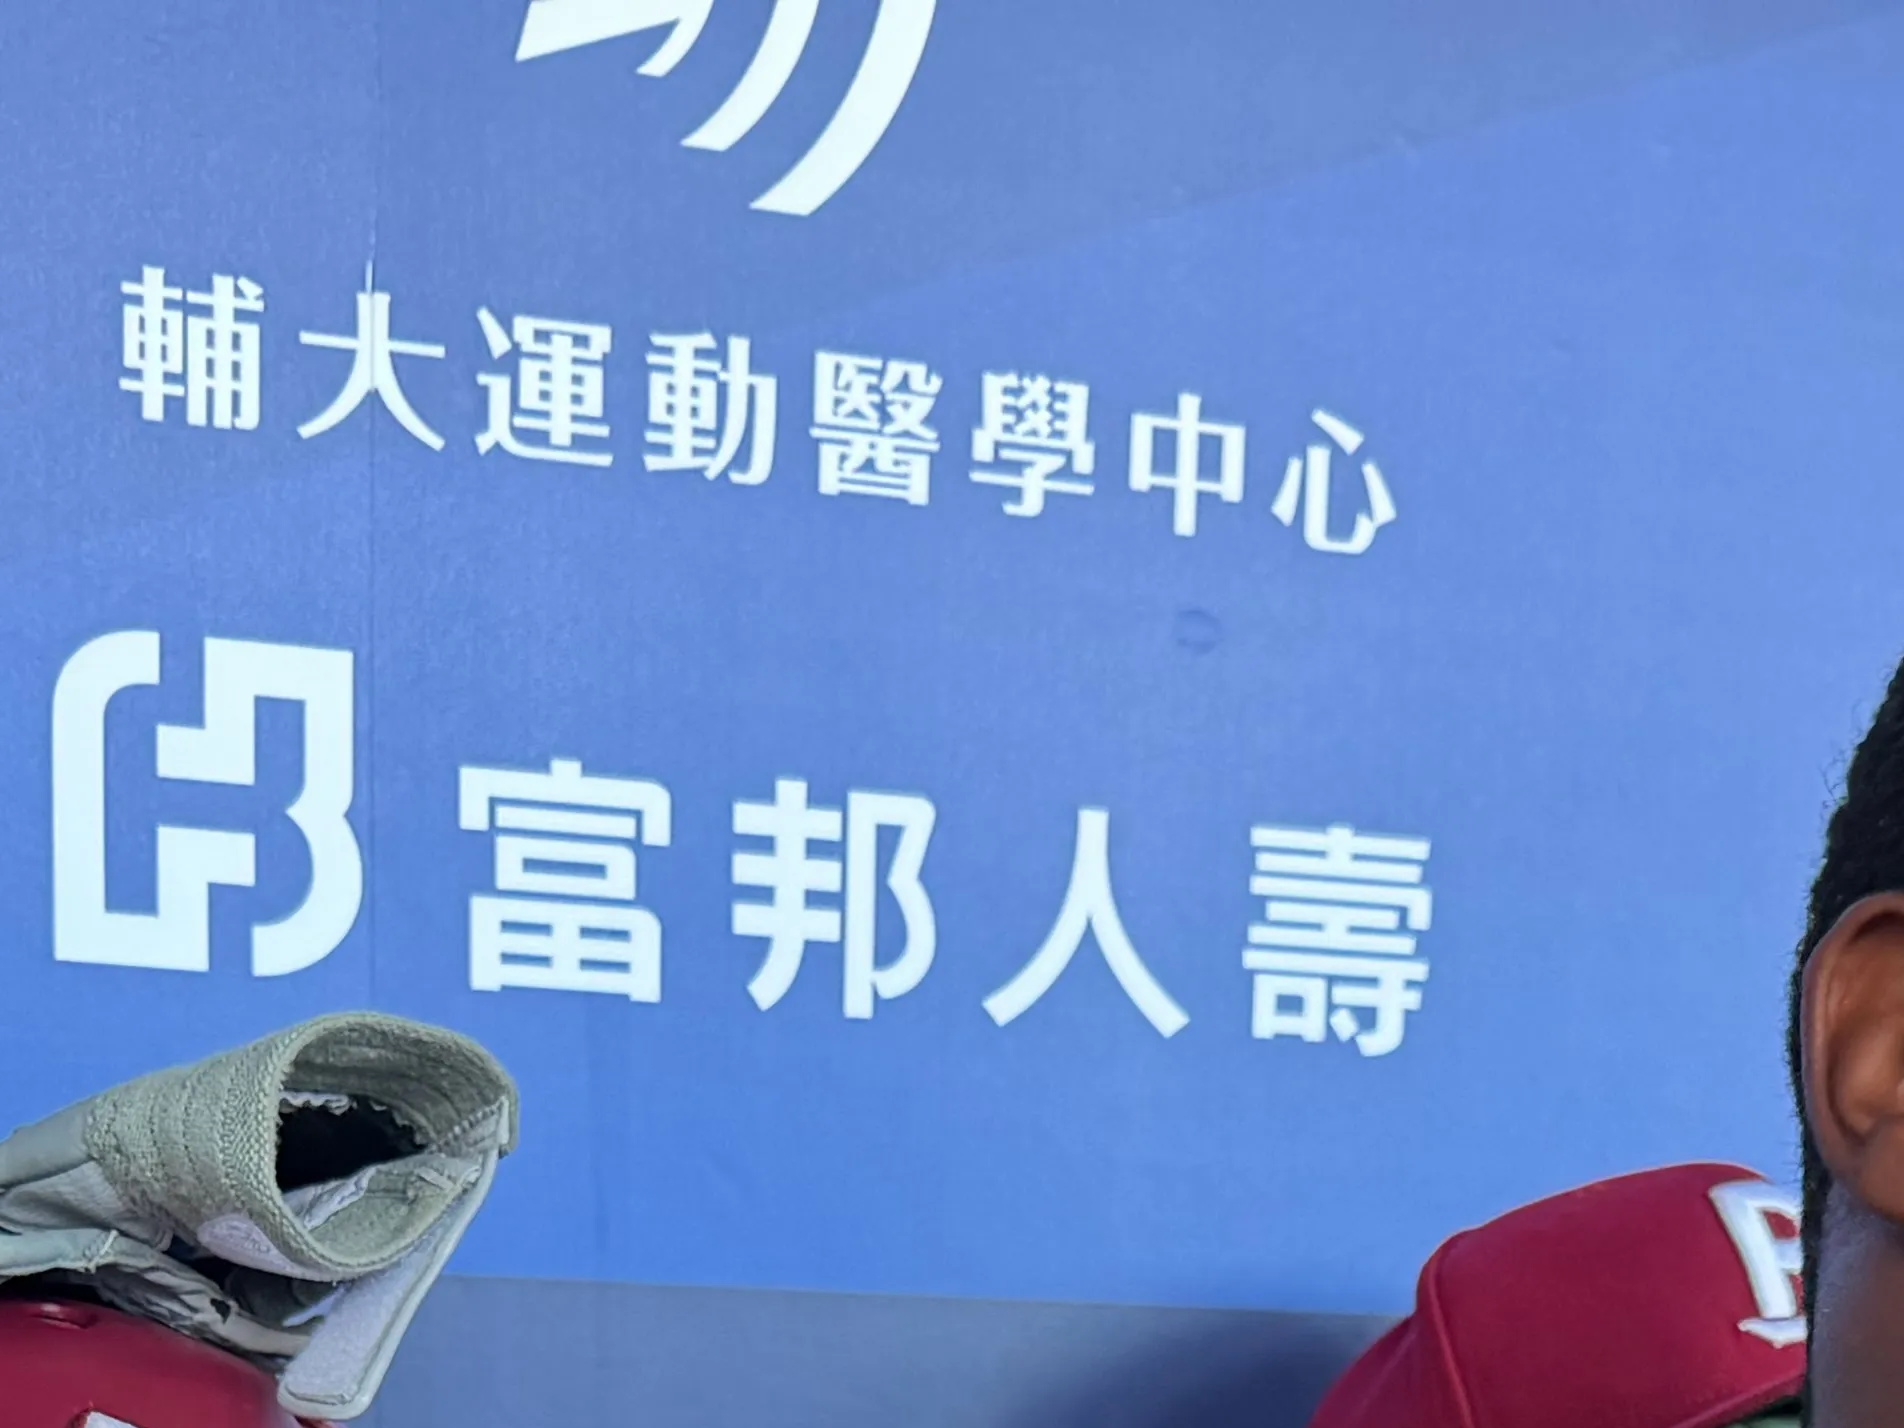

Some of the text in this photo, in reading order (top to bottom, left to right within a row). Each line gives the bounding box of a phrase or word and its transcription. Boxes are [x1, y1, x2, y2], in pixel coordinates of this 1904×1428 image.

[118, 266, 1396, 555] 輔大運動醫學中心
[458, 758, 1434, 1058] 富邦人壽
